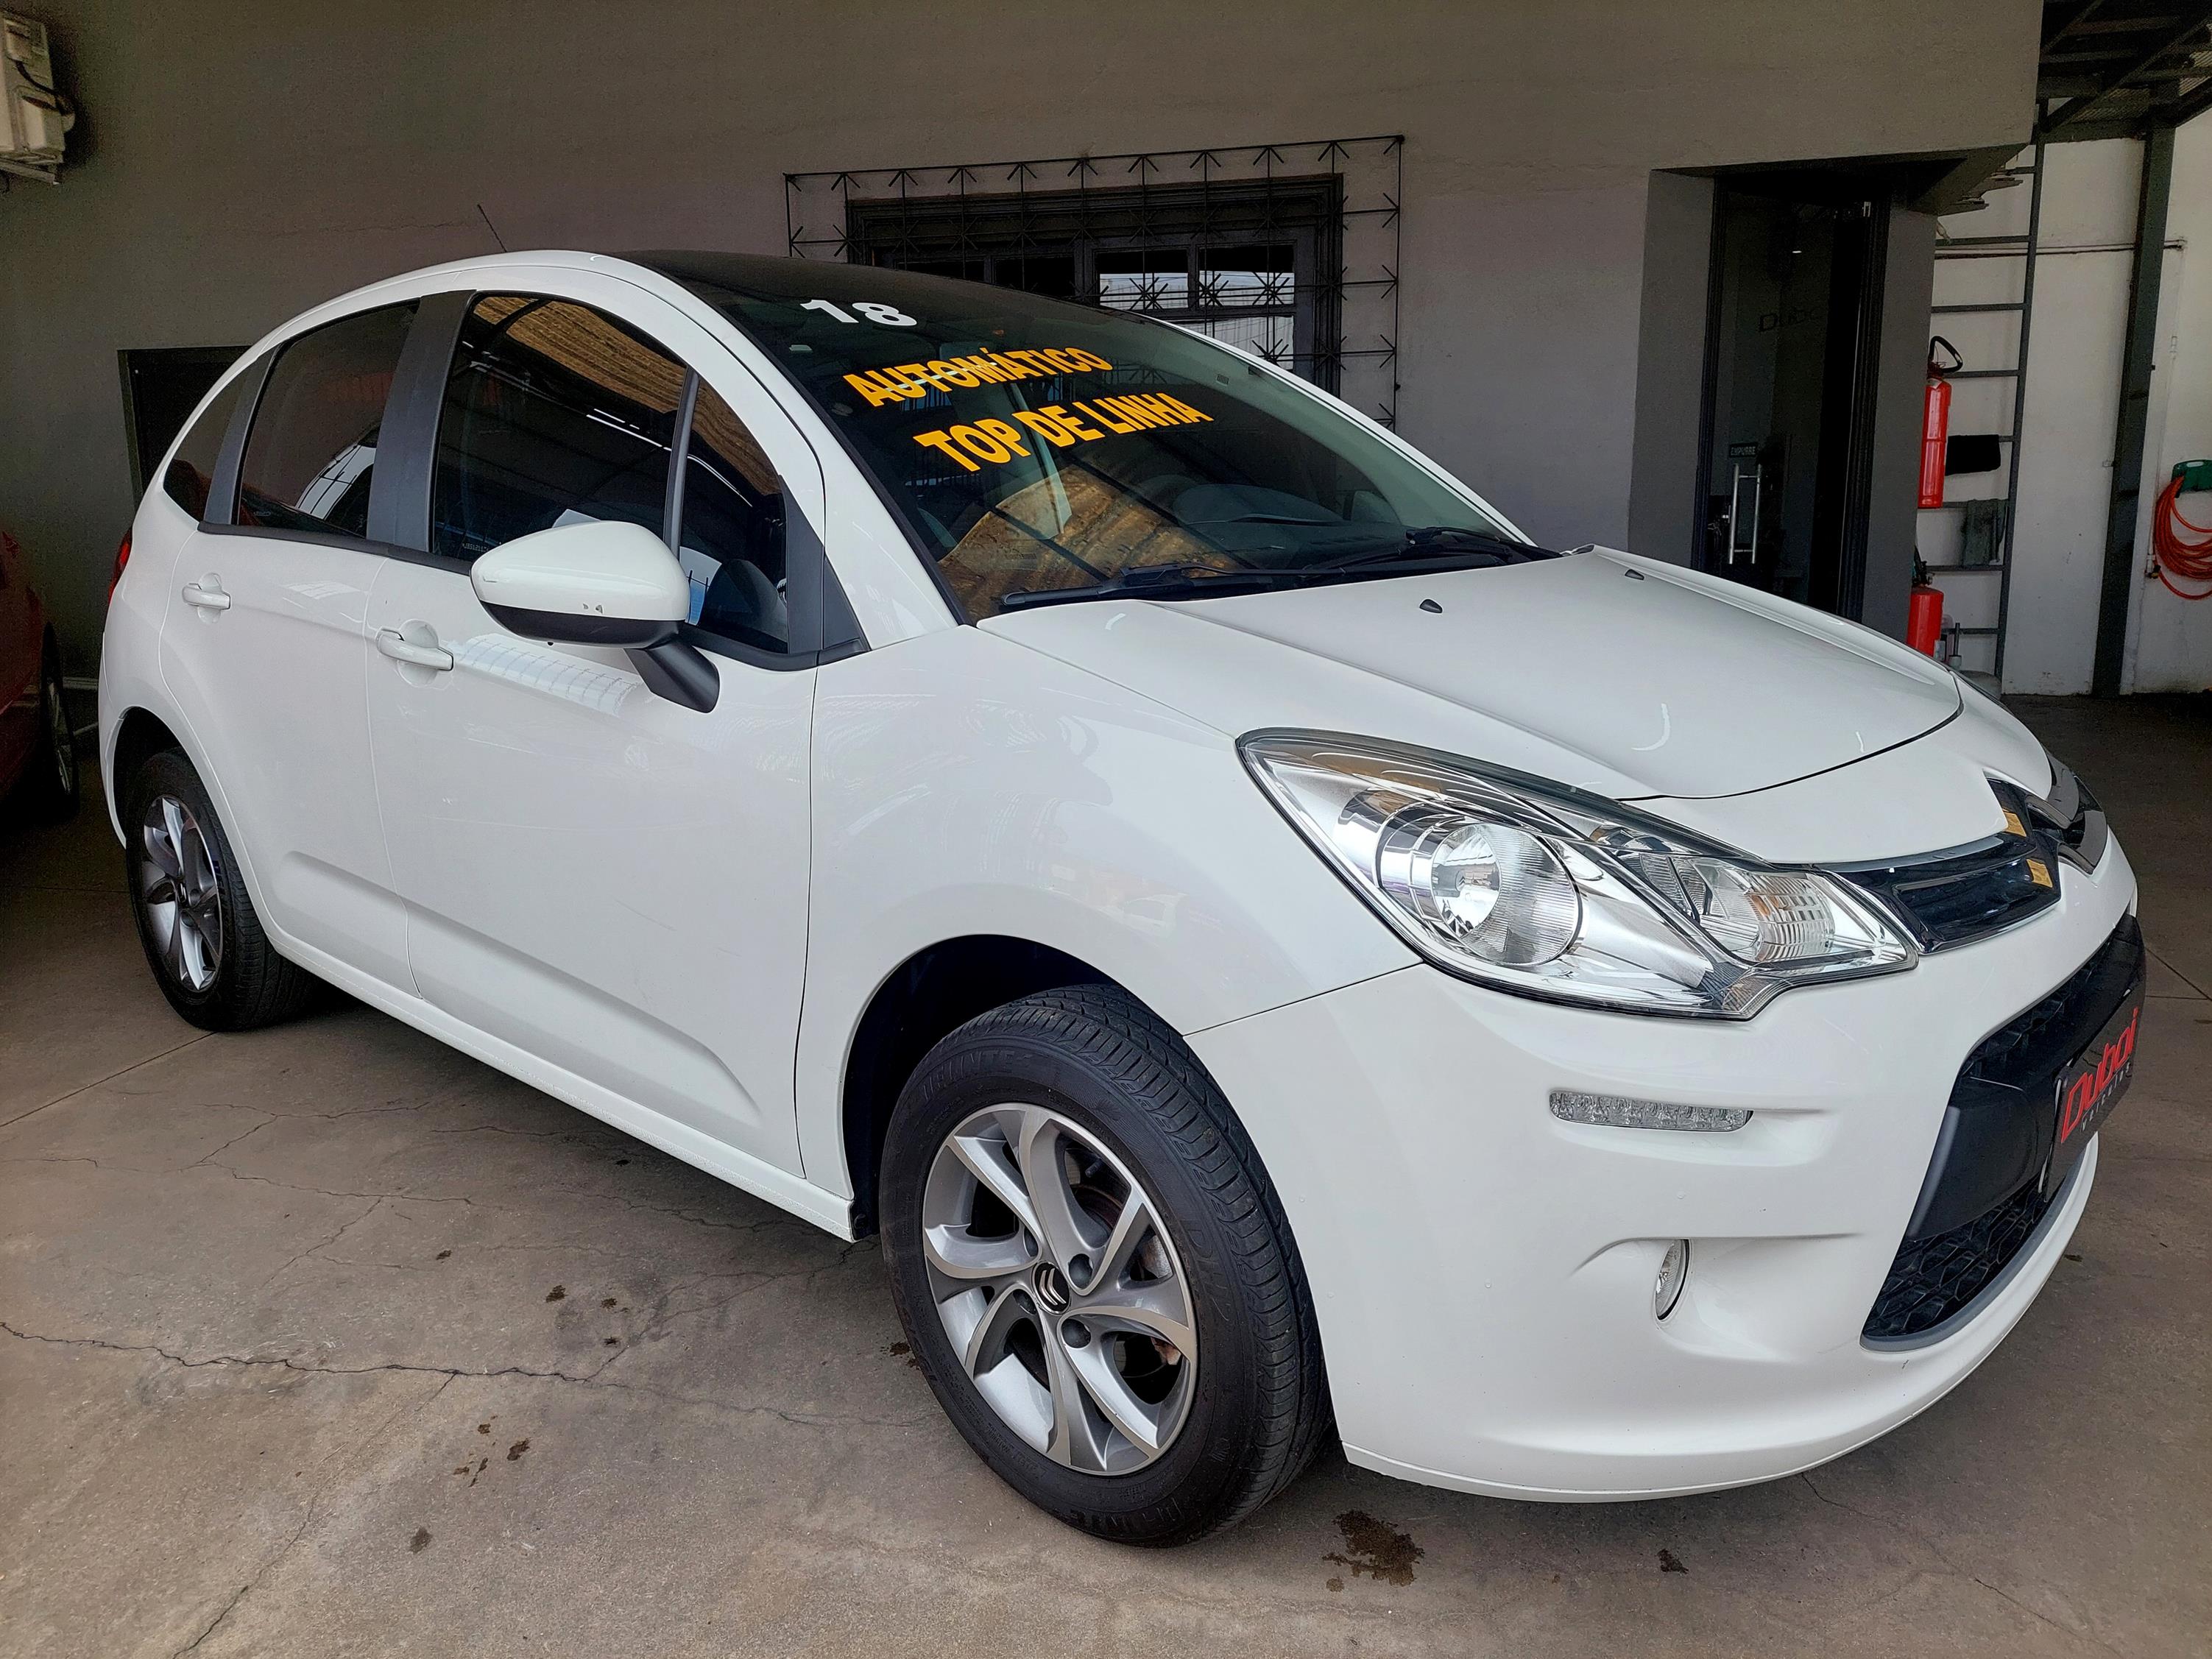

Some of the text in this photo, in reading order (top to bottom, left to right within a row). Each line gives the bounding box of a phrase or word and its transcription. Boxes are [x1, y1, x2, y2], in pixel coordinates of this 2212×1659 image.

[799, 299, 918, 326] 18
[843, 347, 1114, 408] AUTOMÁTICO
[913, 392, 1214, 472] TOP DE LINHA
[2060, 1006, 2139, 1143] Dubai
